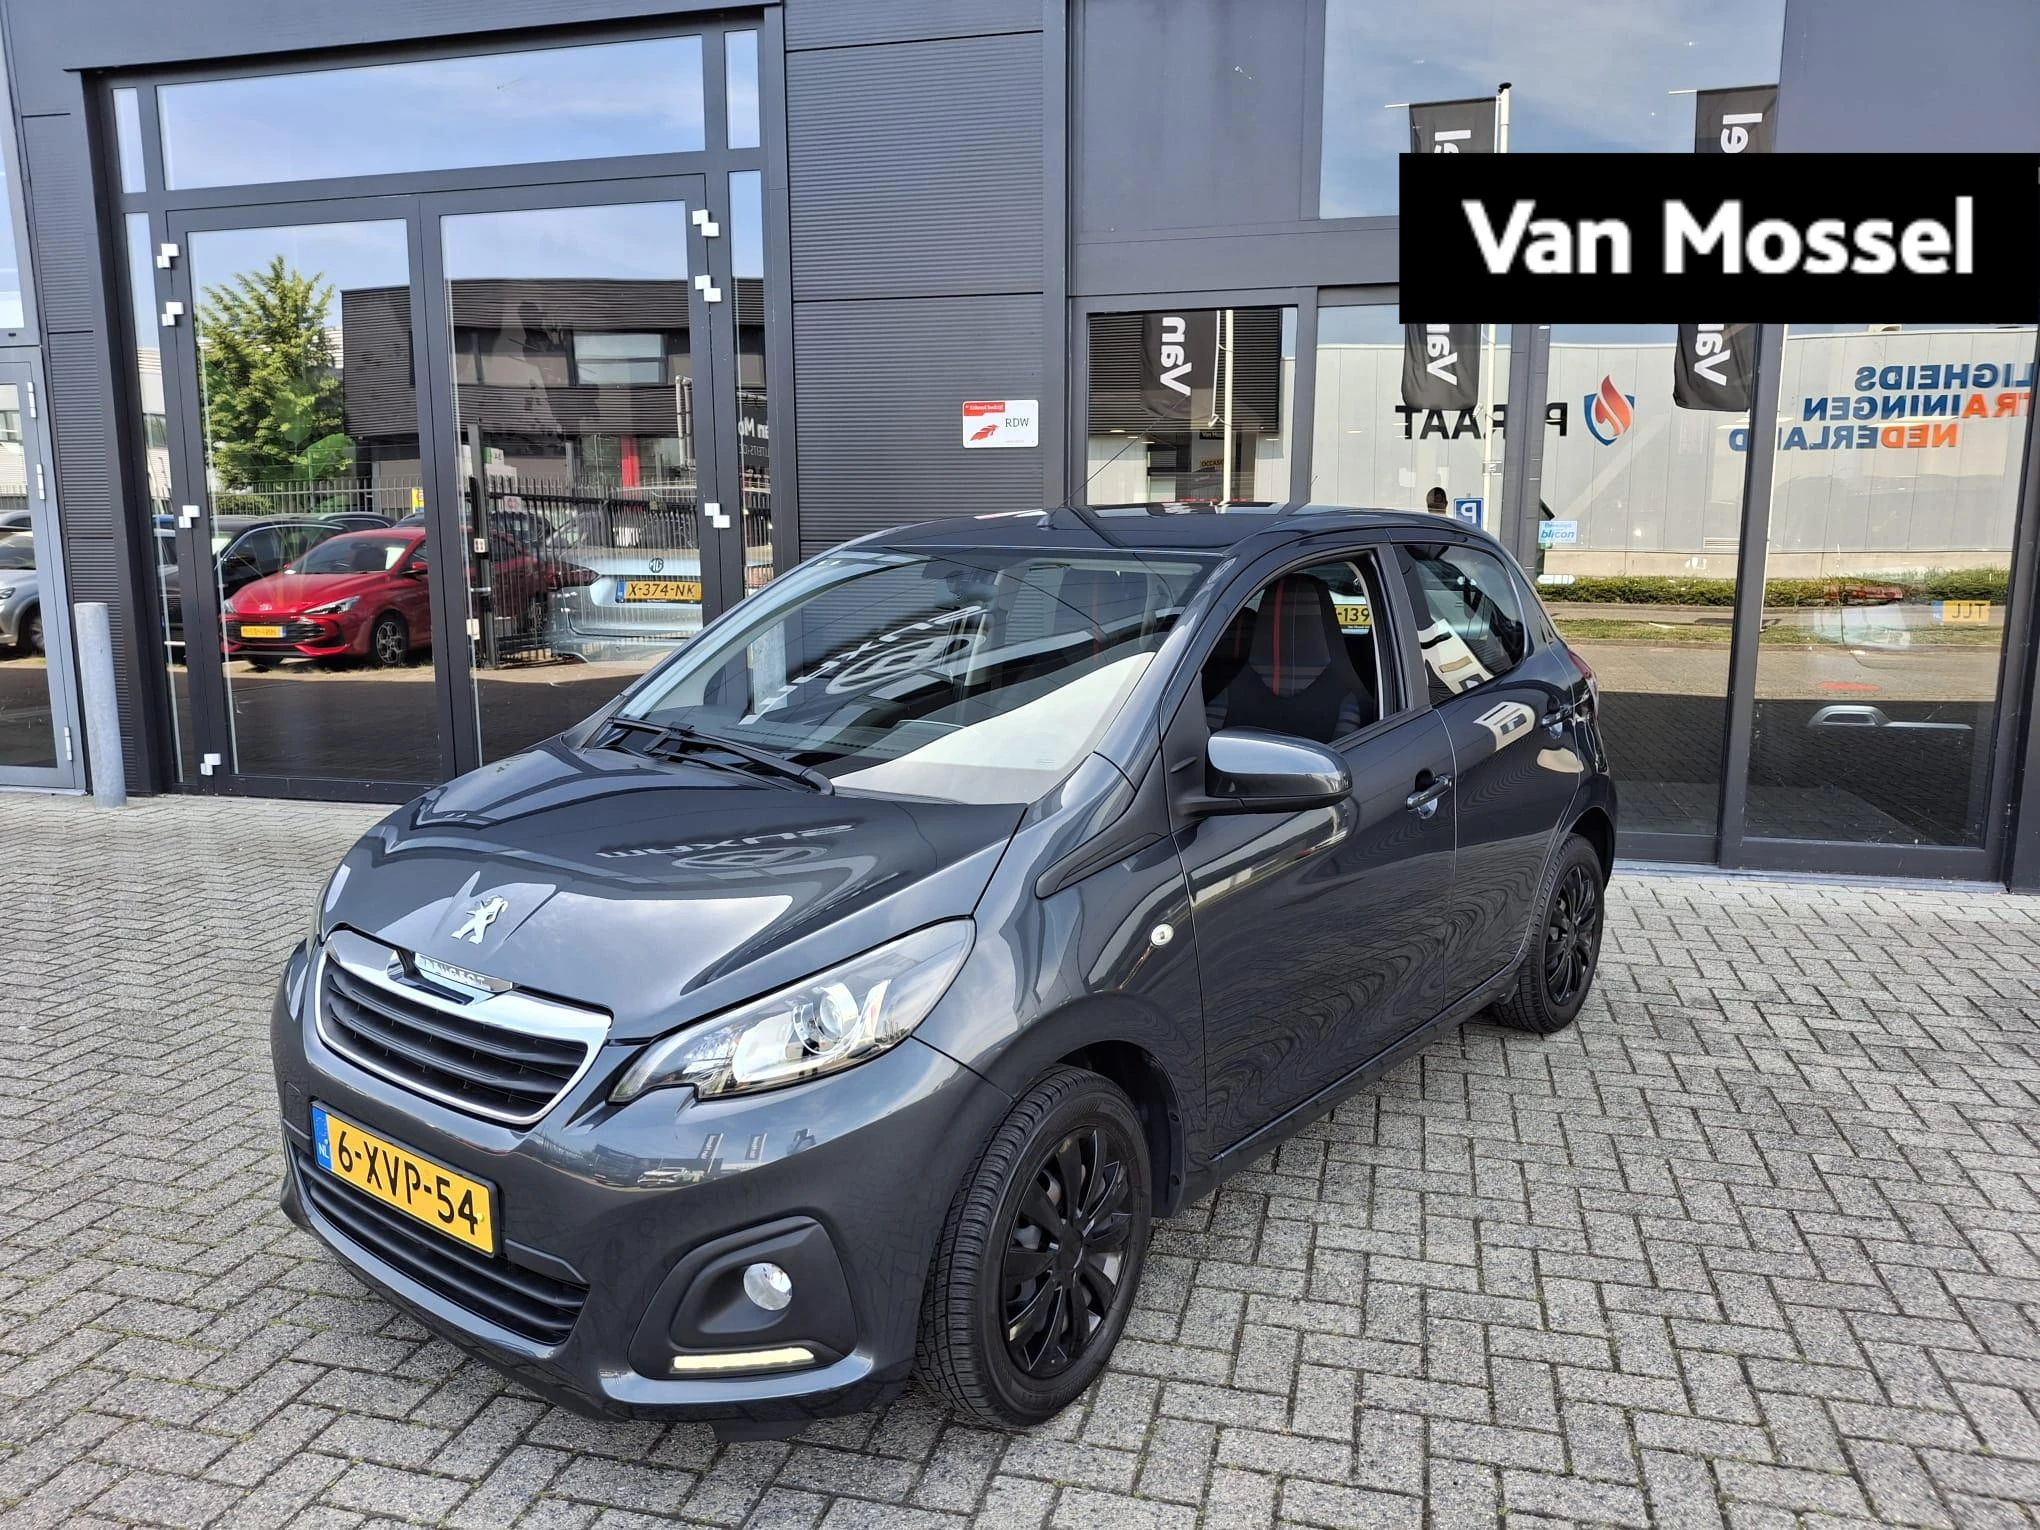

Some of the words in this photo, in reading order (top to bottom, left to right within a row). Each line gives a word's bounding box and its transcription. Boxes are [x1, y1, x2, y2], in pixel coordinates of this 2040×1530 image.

[1005, 418, 1029, 428] RDW
[1540, 530, 1575, 539] blicon
[628, 583, 695, 597] X-374-NK
[318, 1142, 330, 1160] NL
[338, 1130, 479, 1236] 6-XVP-54
